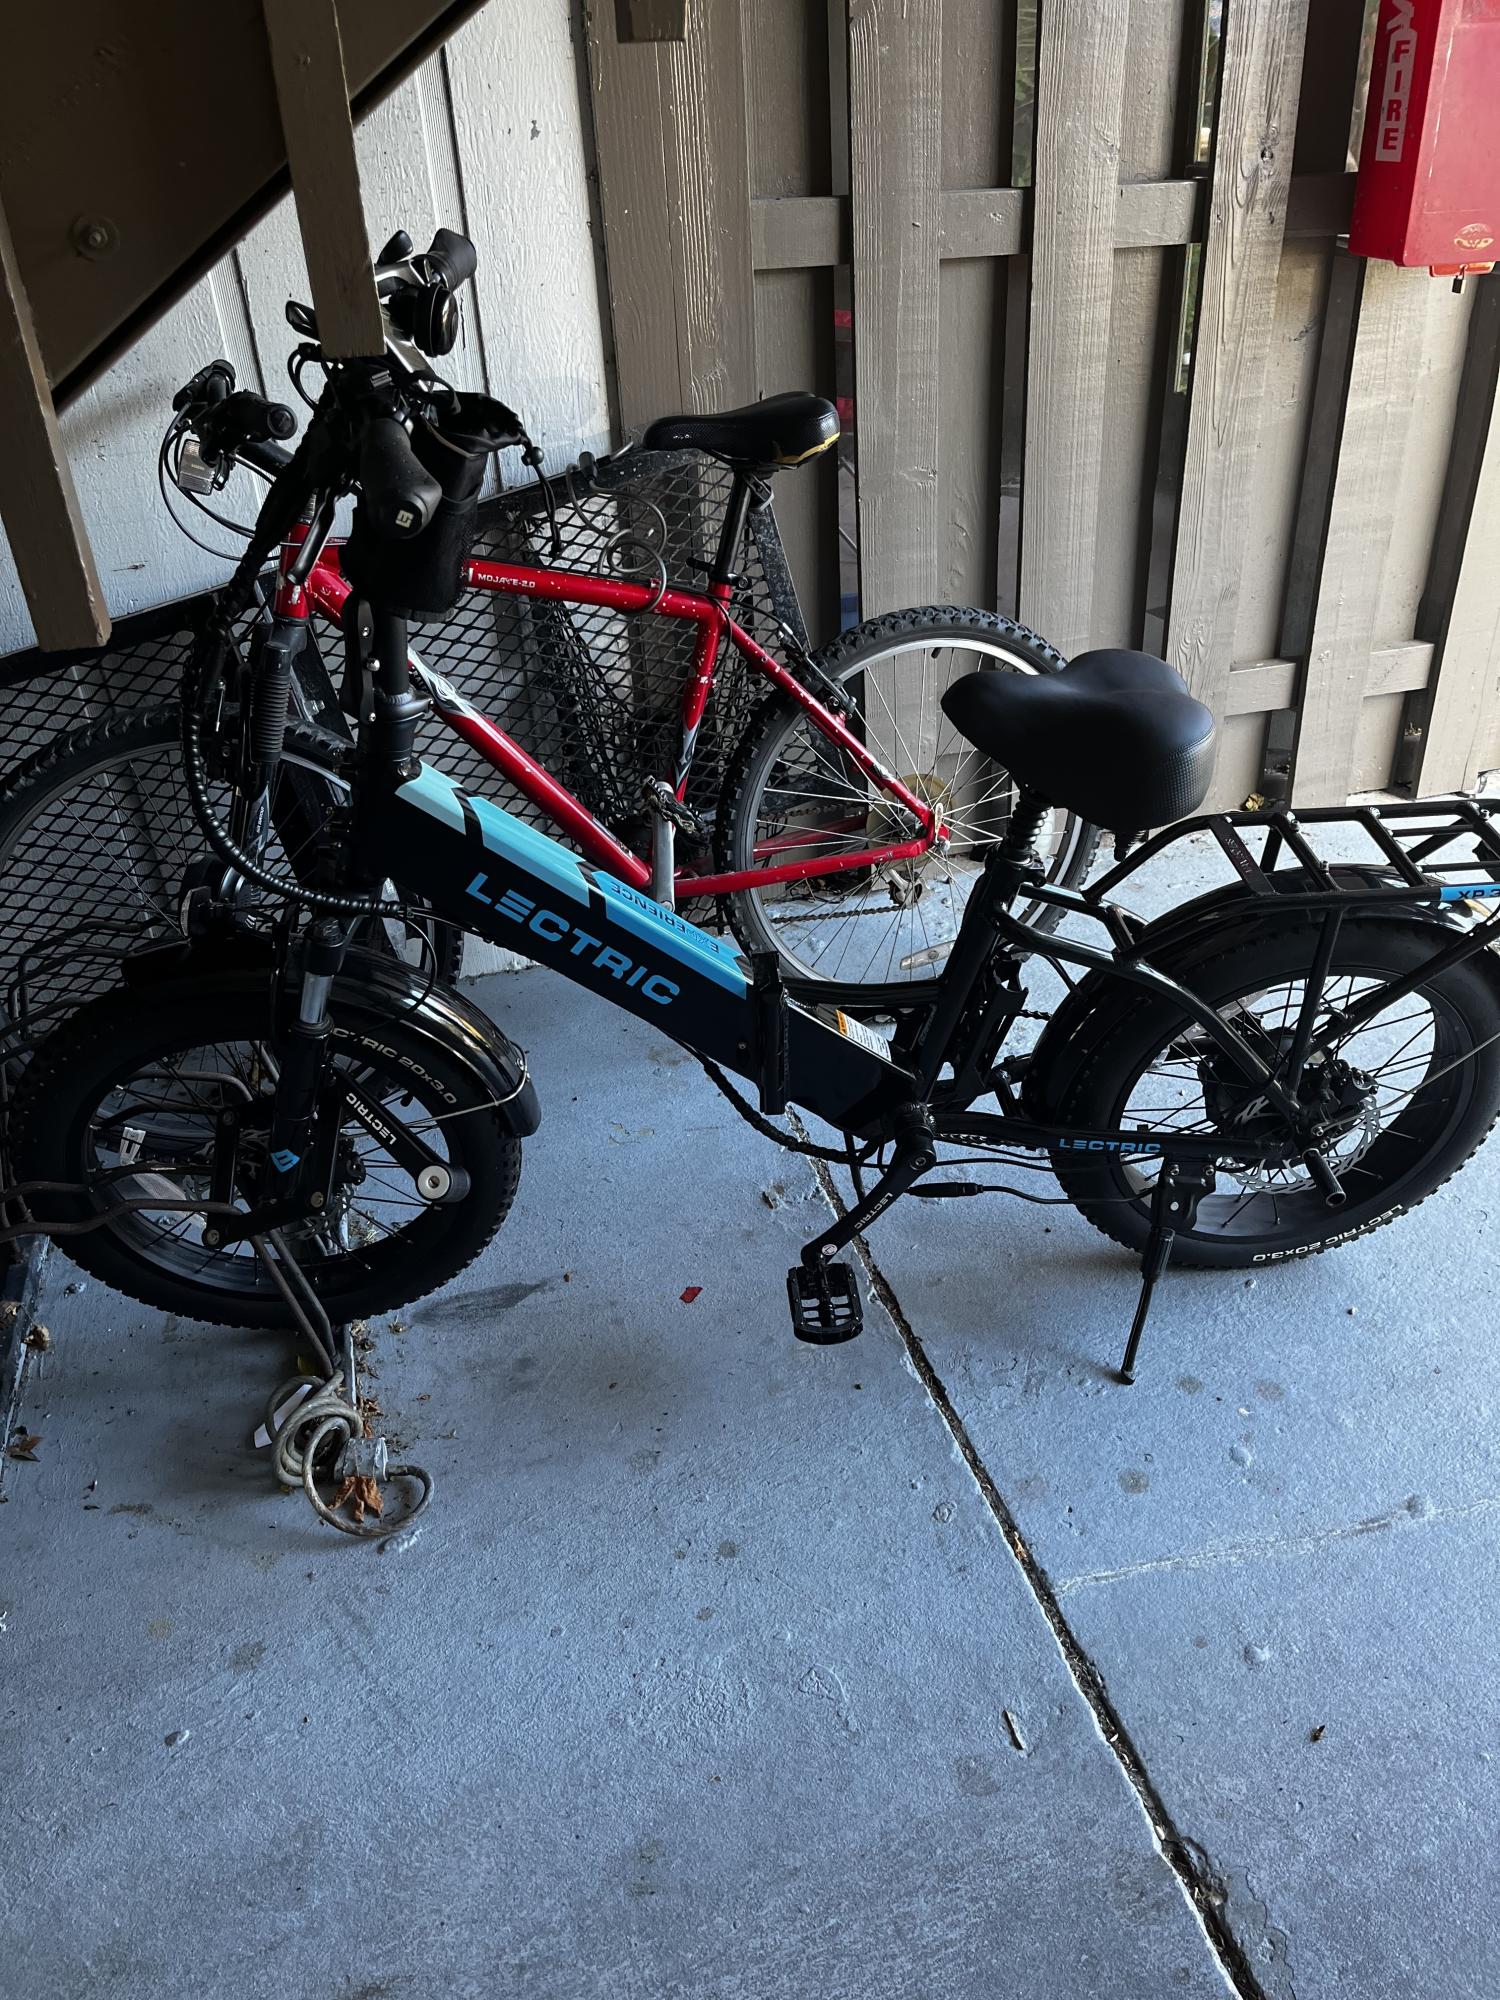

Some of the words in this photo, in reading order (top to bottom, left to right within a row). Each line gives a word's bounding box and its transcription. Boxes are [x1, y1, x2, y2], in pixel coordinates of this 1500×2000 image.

[1382, 40, 1411, 150] FIRE
[1458, 890, 1485, 899] XP
[465, 872, 681, 1005] LECTRIC
[398, 1056, 458, 1105] 20x3.0
[346, 1093, 397, 1145] LECTRIC
[1059, 1138, 1161, 1153] LECTRIC
[854, 1192, 894, 1229] LECTRIC
[1325, 1203, 1404, 1245] LECTRIC
[1252, 1241, 1321, 1262] 20x3.0
